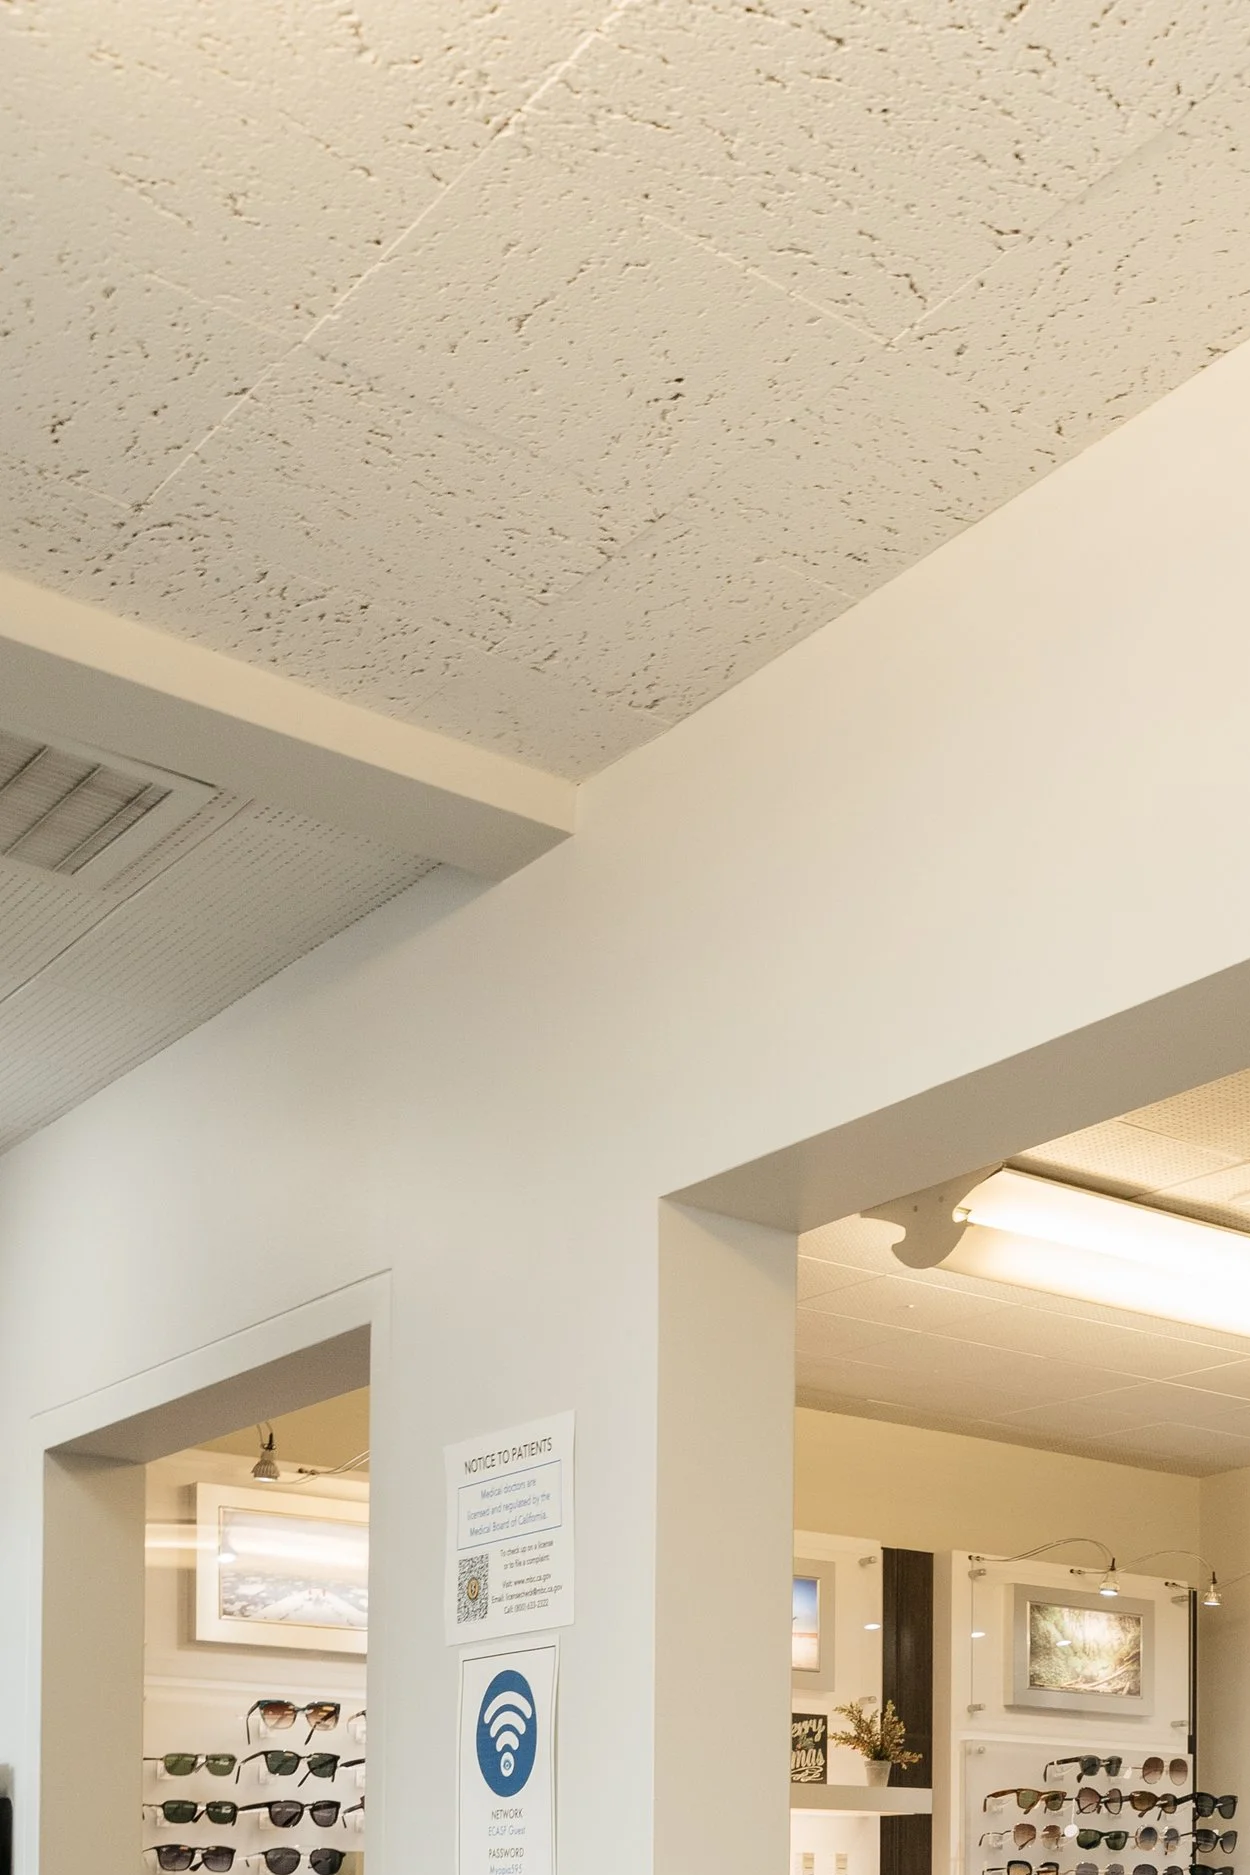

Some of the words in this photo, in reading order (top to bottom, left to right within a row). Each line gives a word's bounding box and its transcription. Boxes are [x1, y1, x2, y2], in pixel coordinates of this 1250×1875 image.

[464, 1453, 496, 1475] NOTICE
[497, 1449, 510, 1465] TO
[511, 1437, 552, 1461] PATIENTS
[480, 1487, 502, 1499] Medical
[470, 1523, 491, 1536] Medical
[491, 1807, 524, 1820] NETWORK
[488, 1847, 525, 1859] PASSWORD
